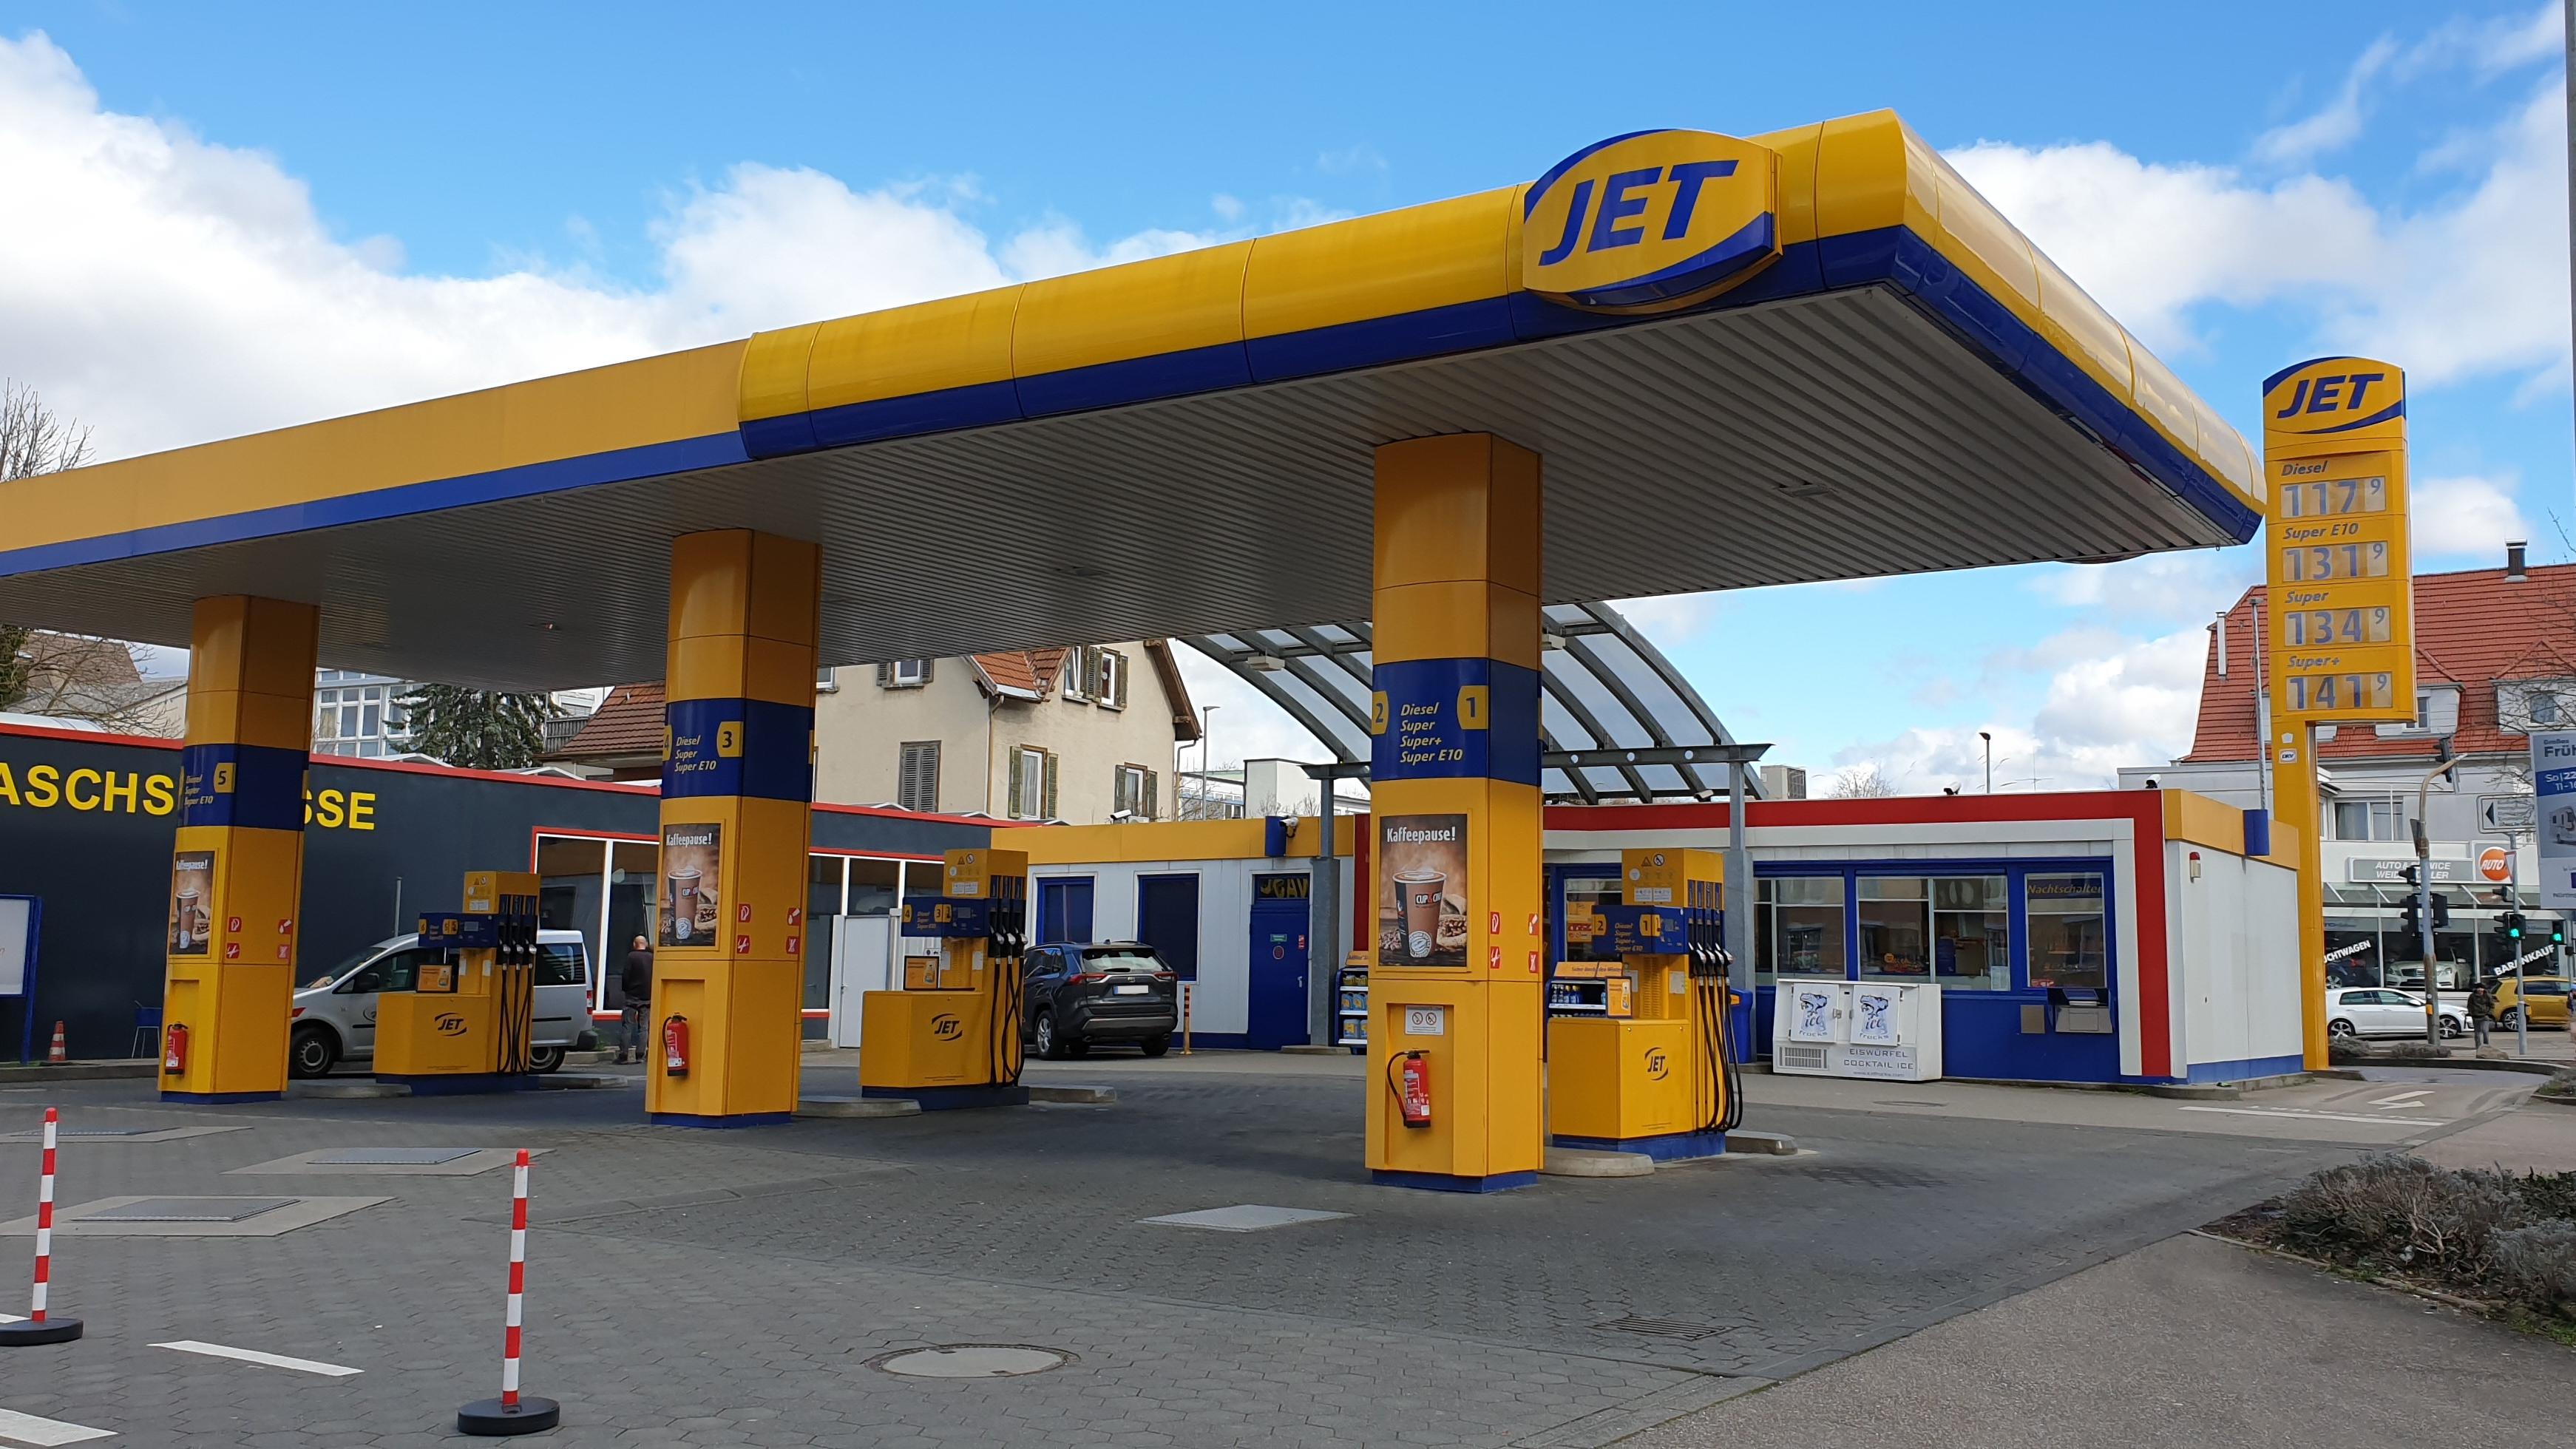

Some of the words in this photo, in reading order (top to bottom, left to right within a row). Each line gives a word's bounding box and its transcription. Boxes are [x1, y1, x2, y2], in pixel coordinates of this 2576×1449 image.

[1539, 160, 1739, 267] JET
[2277, 373, 2385, 419] JET
[2281, 461, 2328, 477] Diesel
[2283, 527, 2326, 542] Super
[2331, 523, 2359, 537] E10
[2285, 591, 2328, 606] Super
[2287, 655, 2340, 671] Super+
[1375, 703, 1383, 723] 2
[1400, 702, 1440, 716] Diesel
[1466, 697, 1476, 718] 1
[1400, 720, 1435, 734] Super
[676, 734, 701, 747] Diesel
[722, 730, 733, 748] 3
[1400, 736, 1442, 750] Super+
[675, 749, 697, 761] Super
[1400, 751, 1435, 766] Super
[1438, 749, 1463, 761] E10
[674, 762, 697, 774] Super
[698, 760, 716, 770] E10
[218, 770, 226, 785] 5
[200, 795, 214, 804] E10
[666, 832, 712, 847] Kaffeepause!
[1387, 827, 1456, 844] Kaffeepause!
[2481, 860, 2504, 870] AUTO
[2027, 883, 2101, 894] Nachtschalter
[936, 909, 940, 917] 3
[1598, 920, 1604, 931] 2
[1643, 920, 1648, 931] 1
[438, 1018, 464, 1031] JET
[935, 1021, 960, 1034] JET
[1647, 1056, 1665, 1072] JET
[1844, 1059, 1893, 1069] COCKTAIL
